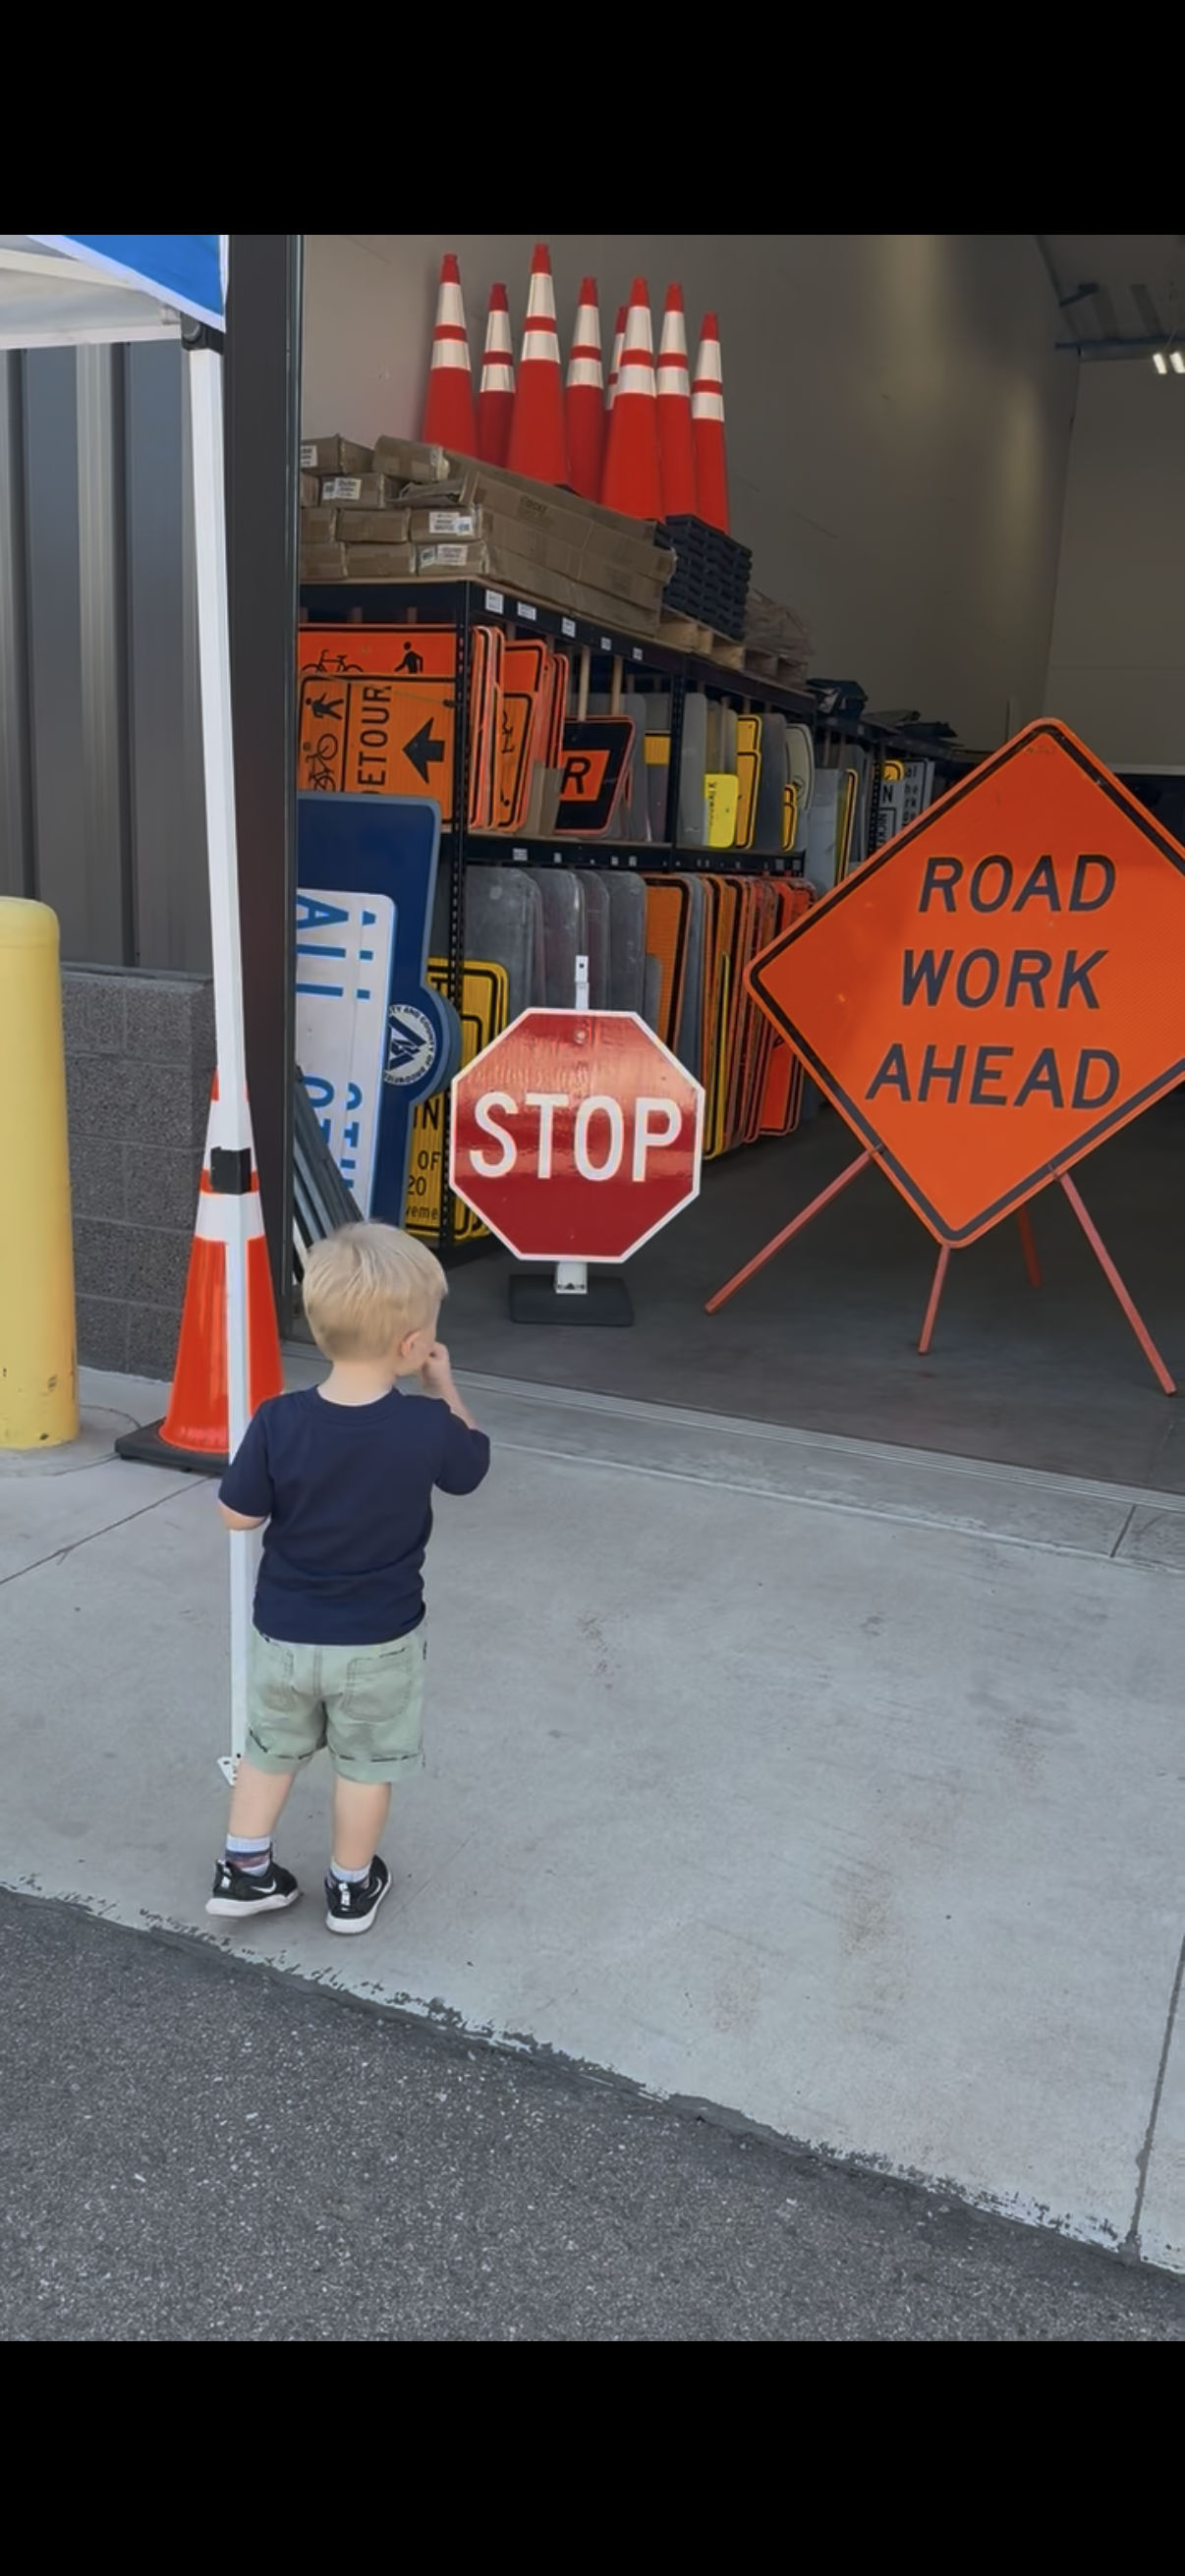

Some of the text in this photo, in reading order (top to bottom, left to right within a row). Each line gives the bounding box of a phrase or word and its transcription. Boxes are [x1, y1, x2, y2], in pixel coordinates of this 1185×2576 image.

[357, 686, 392, 794] ETOUR
[561, 756, 592, 795] R
[918, 854, 1116, 914] ROAD
[901, 948, 1110, 1010] WORK
[864, 1042, 1121, 1111] AHEAD
[469, 1091, 683, 1183] STOP
